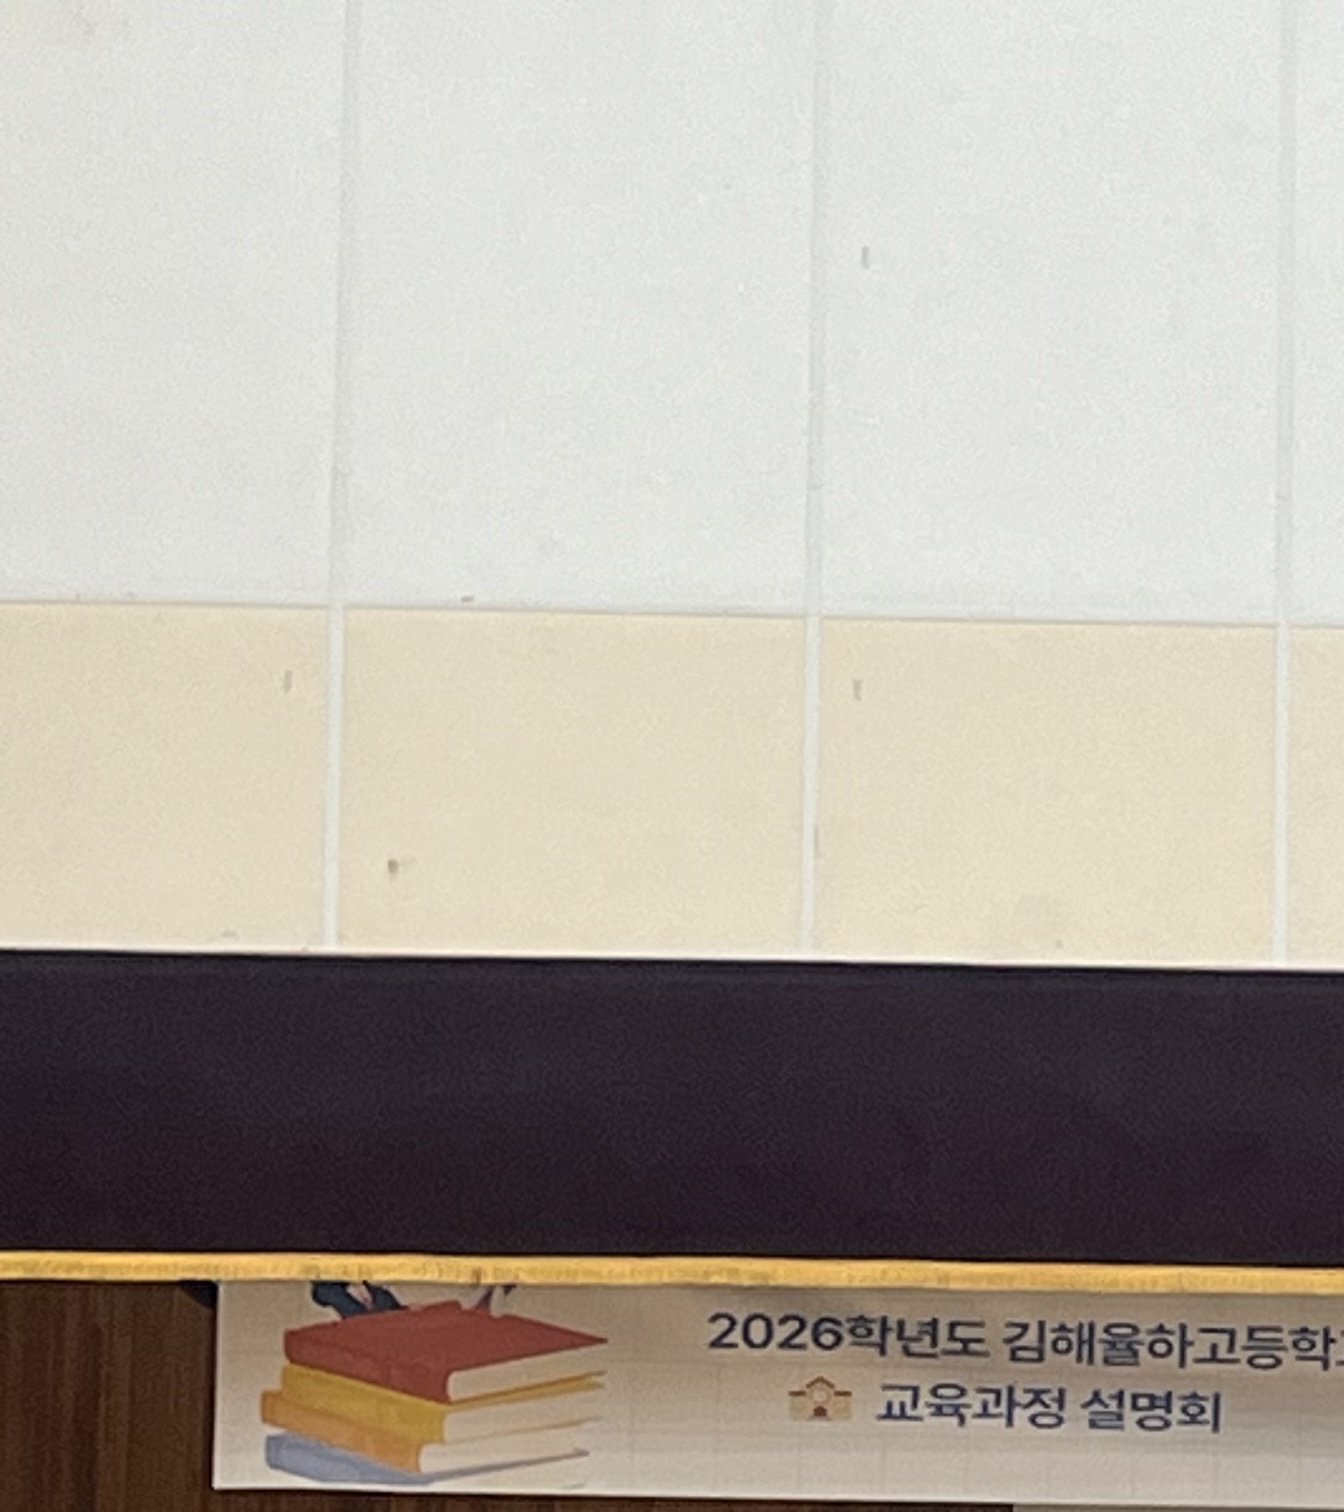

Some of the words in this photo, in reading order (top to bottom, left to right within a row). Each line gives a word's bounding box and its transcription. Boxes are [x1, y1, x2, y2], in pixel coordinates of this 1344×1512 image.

[708, 1312, 991, 1359] 2026학년도
[876, 1384, 1067, 1430] 교육과정
[1080, 1391, 1222, 1434] 설명회
